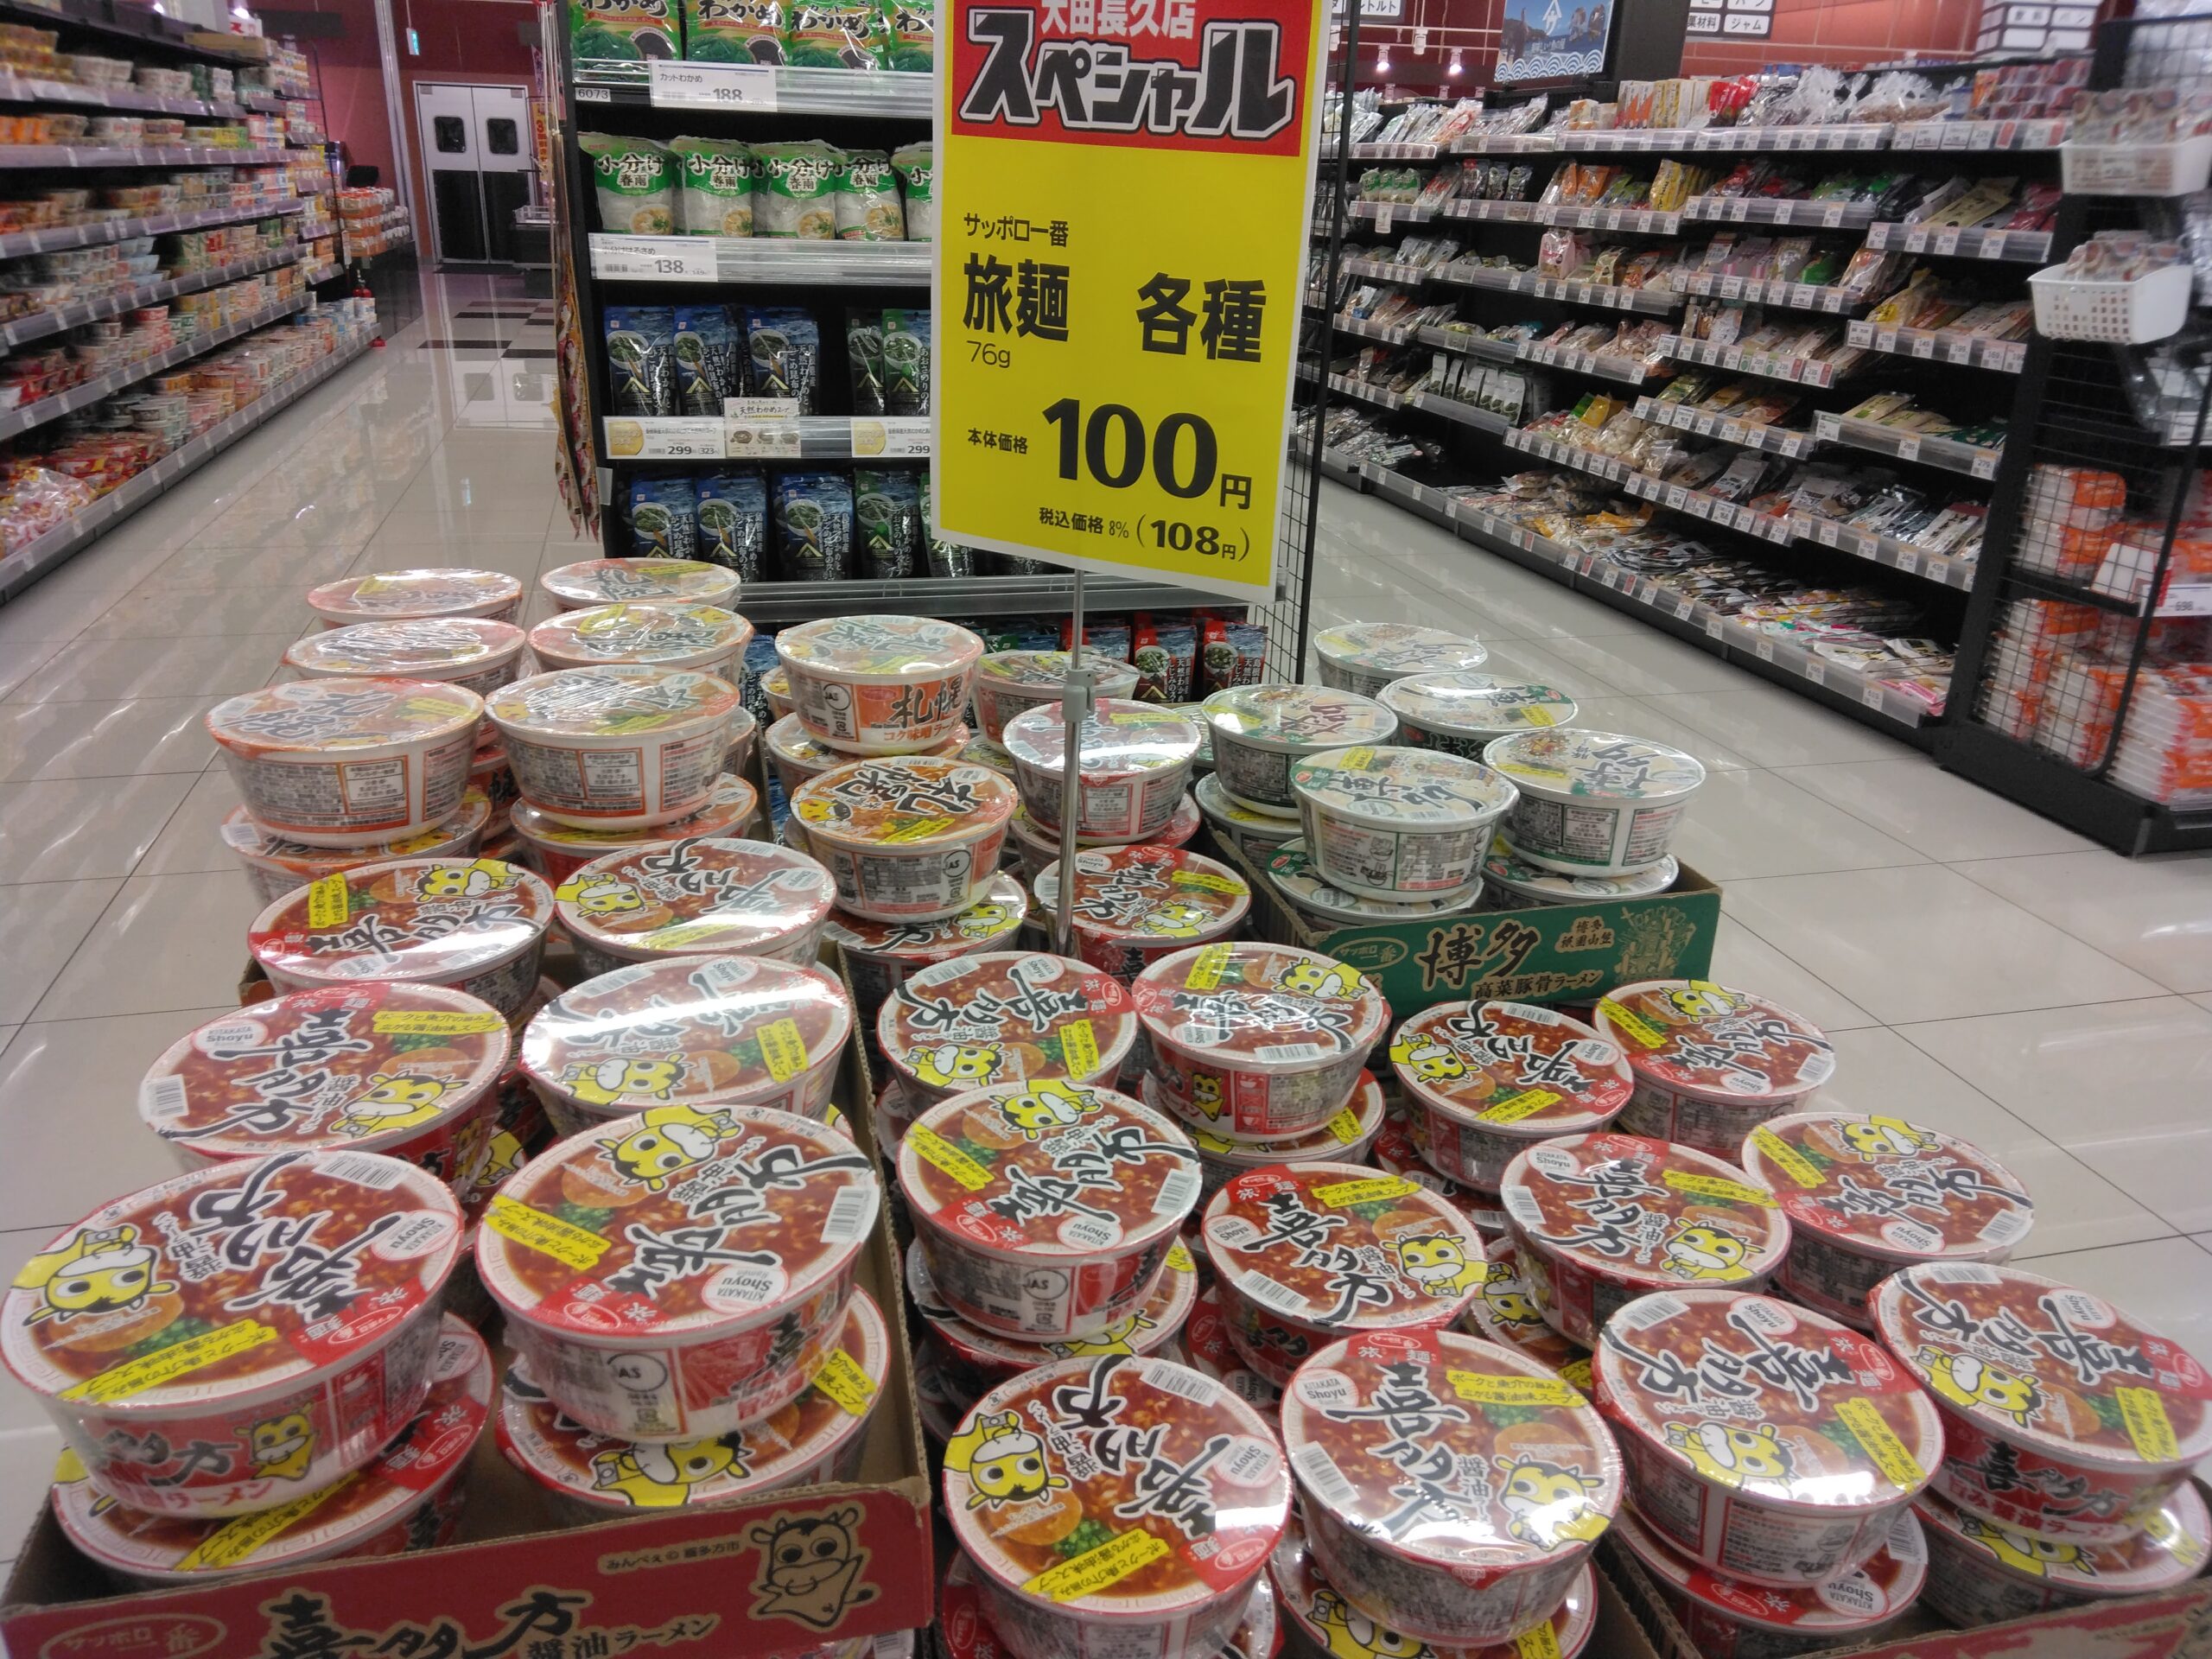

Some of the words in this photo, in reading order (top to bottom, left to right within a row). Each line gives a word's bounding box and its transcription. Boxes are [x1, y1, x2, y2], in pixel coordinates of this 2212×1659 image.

[1731, 17, 1763, 31] ジャム
[659, 73, 702, 83] カットわかめ
[960, 8, 1294, 139] スペシャル
[578, 90, 608, 99] 6073
[713, 88, 743, 102] 188
[963, 213, 1069, 247] サッポロ一番
[654, 259, 683, 273] 138
[963, 252, 1070, 342] 旅麺
[1135, 271, 1267, 363] 各種
[965, 340, 1011, 369] 76g
[668, 446, 691, 455] 299
[908, 445, 930, 454] 299
[967, 428, 1028, 454] 本体価格
[1039, 506, 1104, 535] 税込価格
[1108, 520, 1129, 539] 8%
[1420, 924, 1537, 987] 博多
[894, 968, 1089, 1031] 喜多方
[1475, 969, 1603, 1000] 高菜豚骨ラーメン
[207, 1031, 254, 1042] Shoyu
[1454, 1001, 1594, 1093] 喜多方
[158, 1011, 373, 1141] 喜多方
[989, 1129, 1199, 1224] 喜多方
[1536, 1158, 1571, 1168] Shoyu
[1547, 1158, 1669, 1255] 喜多方
[1821, 1168, 2032, 1236] 喜多方
[188, 1153, 404, 1320] 喜多方
[388, 1216, 436, 1249] Shoyu
[609, 1145, 874, 1298] 喜多方
[1071, 1224, 1111, 1239] Shoyu
[1218, 1225, 1249, 1241] Shoyu
[1243, 1193, 1390, 1324] 喜多方
[721, 1277, 772, 1291] Shoyu
[1744, 1304, 1779, 1329] Shoyu
[2068, 1294, 2091, 1321] Shoyu
[1899, 1274, 2152, 1384] 喜多方
[1602, 1313, 1853, 1410] 喜多方
[1303, 1377, 1340, 1391] KITAKATA
[1306, 1386, 1347, 1401] Shoyu
[1053, 1357, 1228, 1536] 喜多方
[1231, 1446, 1262, 1475] Shoyu
[1458, 1455, 1491, 1522] 醤油ラーメ
[62, 1626, 200, 1651] サッポロ一番
[529, 1616, 714, 1659] 醤油ラーメン
